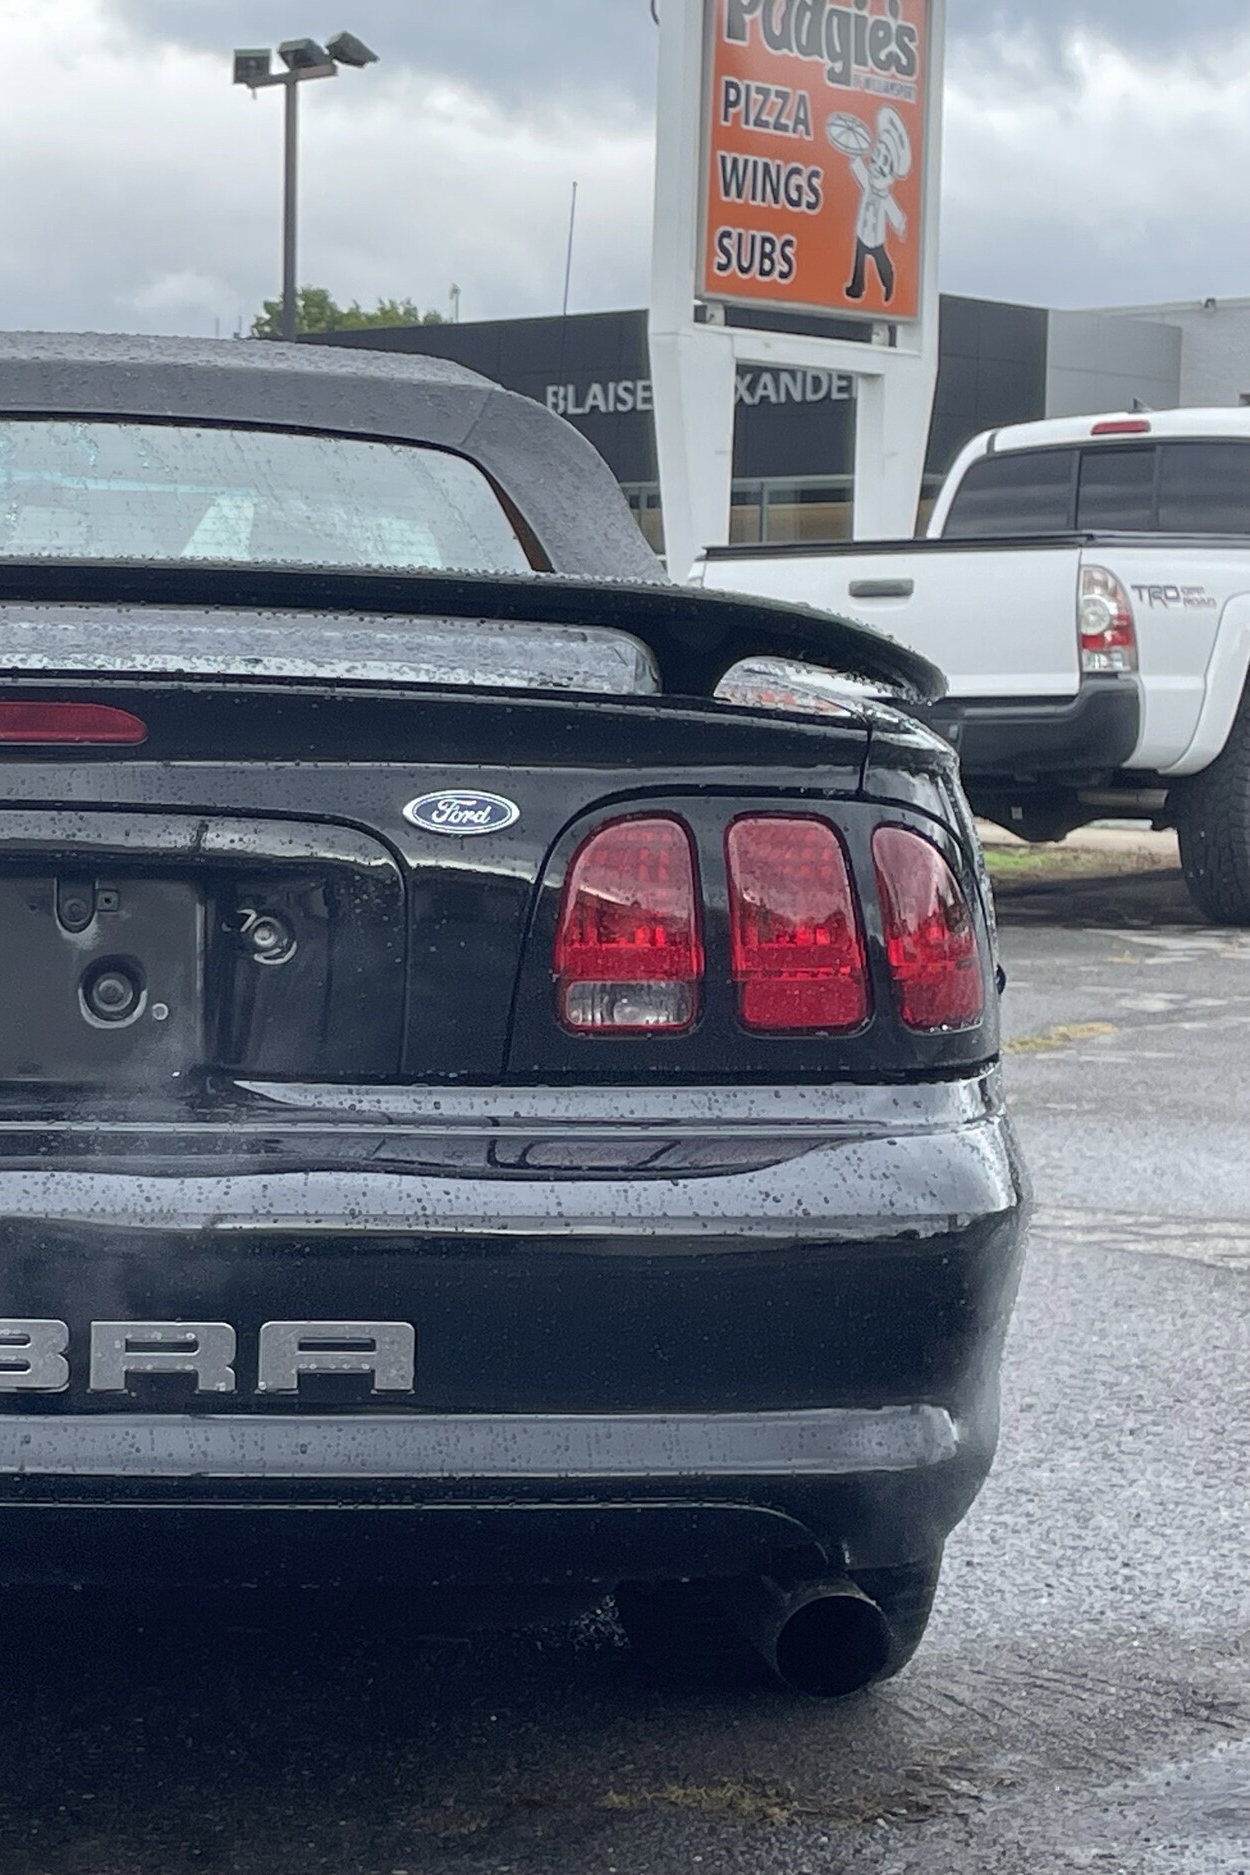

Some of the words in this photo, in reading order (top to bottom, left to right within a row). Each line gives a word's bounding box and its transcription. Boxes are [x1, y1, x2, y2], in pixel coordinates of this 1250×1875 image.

[723, 79, 811, 137] PIZZA
[719, 155, 822, 211] WINGS
[716, 230, 794, 280] SUBS
[546, 379, 654, 415] BLAISE
[431, 798, 492, 824] Ford
